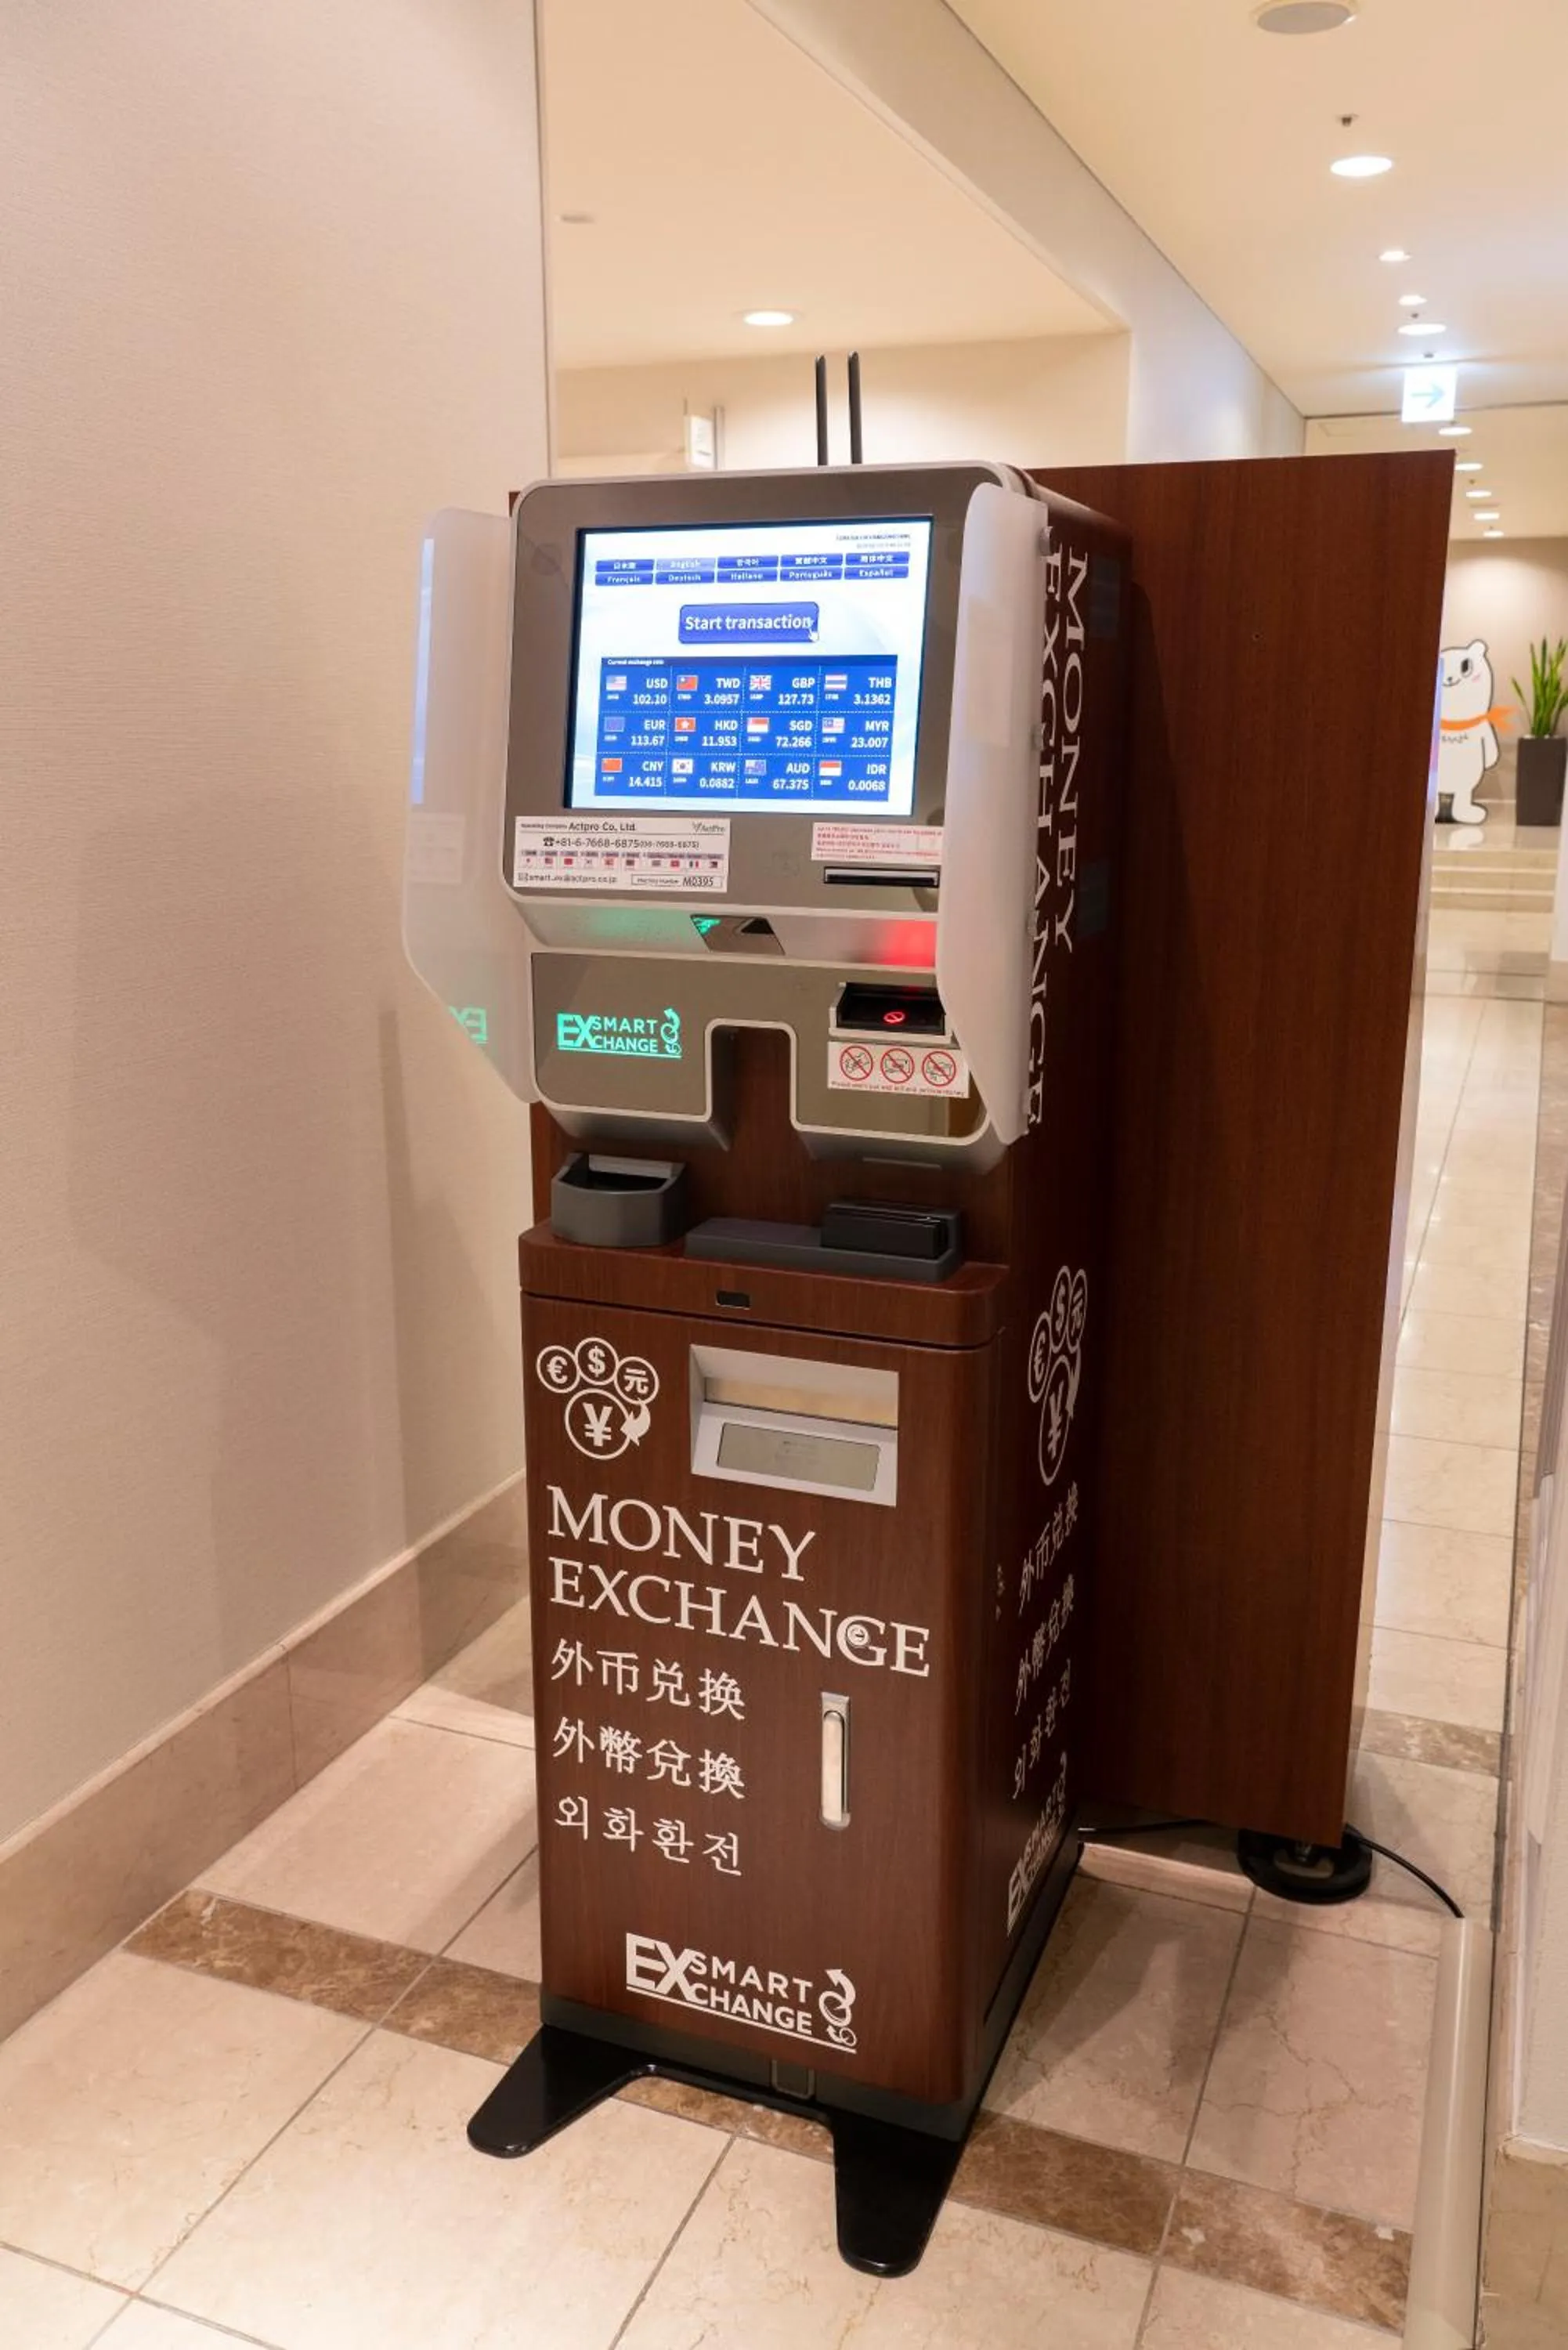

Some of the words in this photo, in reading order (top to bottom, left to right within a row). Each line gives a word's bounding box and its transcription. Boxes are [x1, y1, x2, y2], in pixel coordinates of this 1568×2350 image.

[685, 616, 722, 630] Start
[725, 615, 811, 630] transaction
[646, 678, 668, 689] USD
[716, 678, 740, 689] TWD
[792, 678, 815, 689] GBP
[869, 678, 892, 689] THB
[633, 693, 667, 705] 102.10
[779, 693, 815, 705] 127.73
[644, 719, 665, 731] EUR
[714, 720, 738, 731] HKD
[789, 720, 813, 731] SGD
[865, 721, 889, 732] MYR
[630, 735, 665, 747] 113.67
[702, 736, 737, 747] 11.953
[851, 737, 888, 748] 23.007
[1056, 546, 1088, 953] MONEY
[642, 761, 664, 772] CNY
[710, 761, 736, 772] KRW
[786, 763, 810, 774] AUD
[866, 764, 887, 775] IDR
[629, 776, 663, 787] 14.415
[773, 779, 809, 790] 67.375
[848, 780, 886, 791] 0.0068
[569, 822, 599, 832] Actpro
[592, 1015, 658, 1035] SMART
[623, 1367, 649, 1394] 元
[547, 1484, 816, 1582] MONEY
[548, 1556, 930, 1678] EXCHANGE
[551, 1637, 746, 1721] 外币兑换
[554, 1795, 742, 1877] 외화환전
[688, 1948, 814, 2004] SMART
